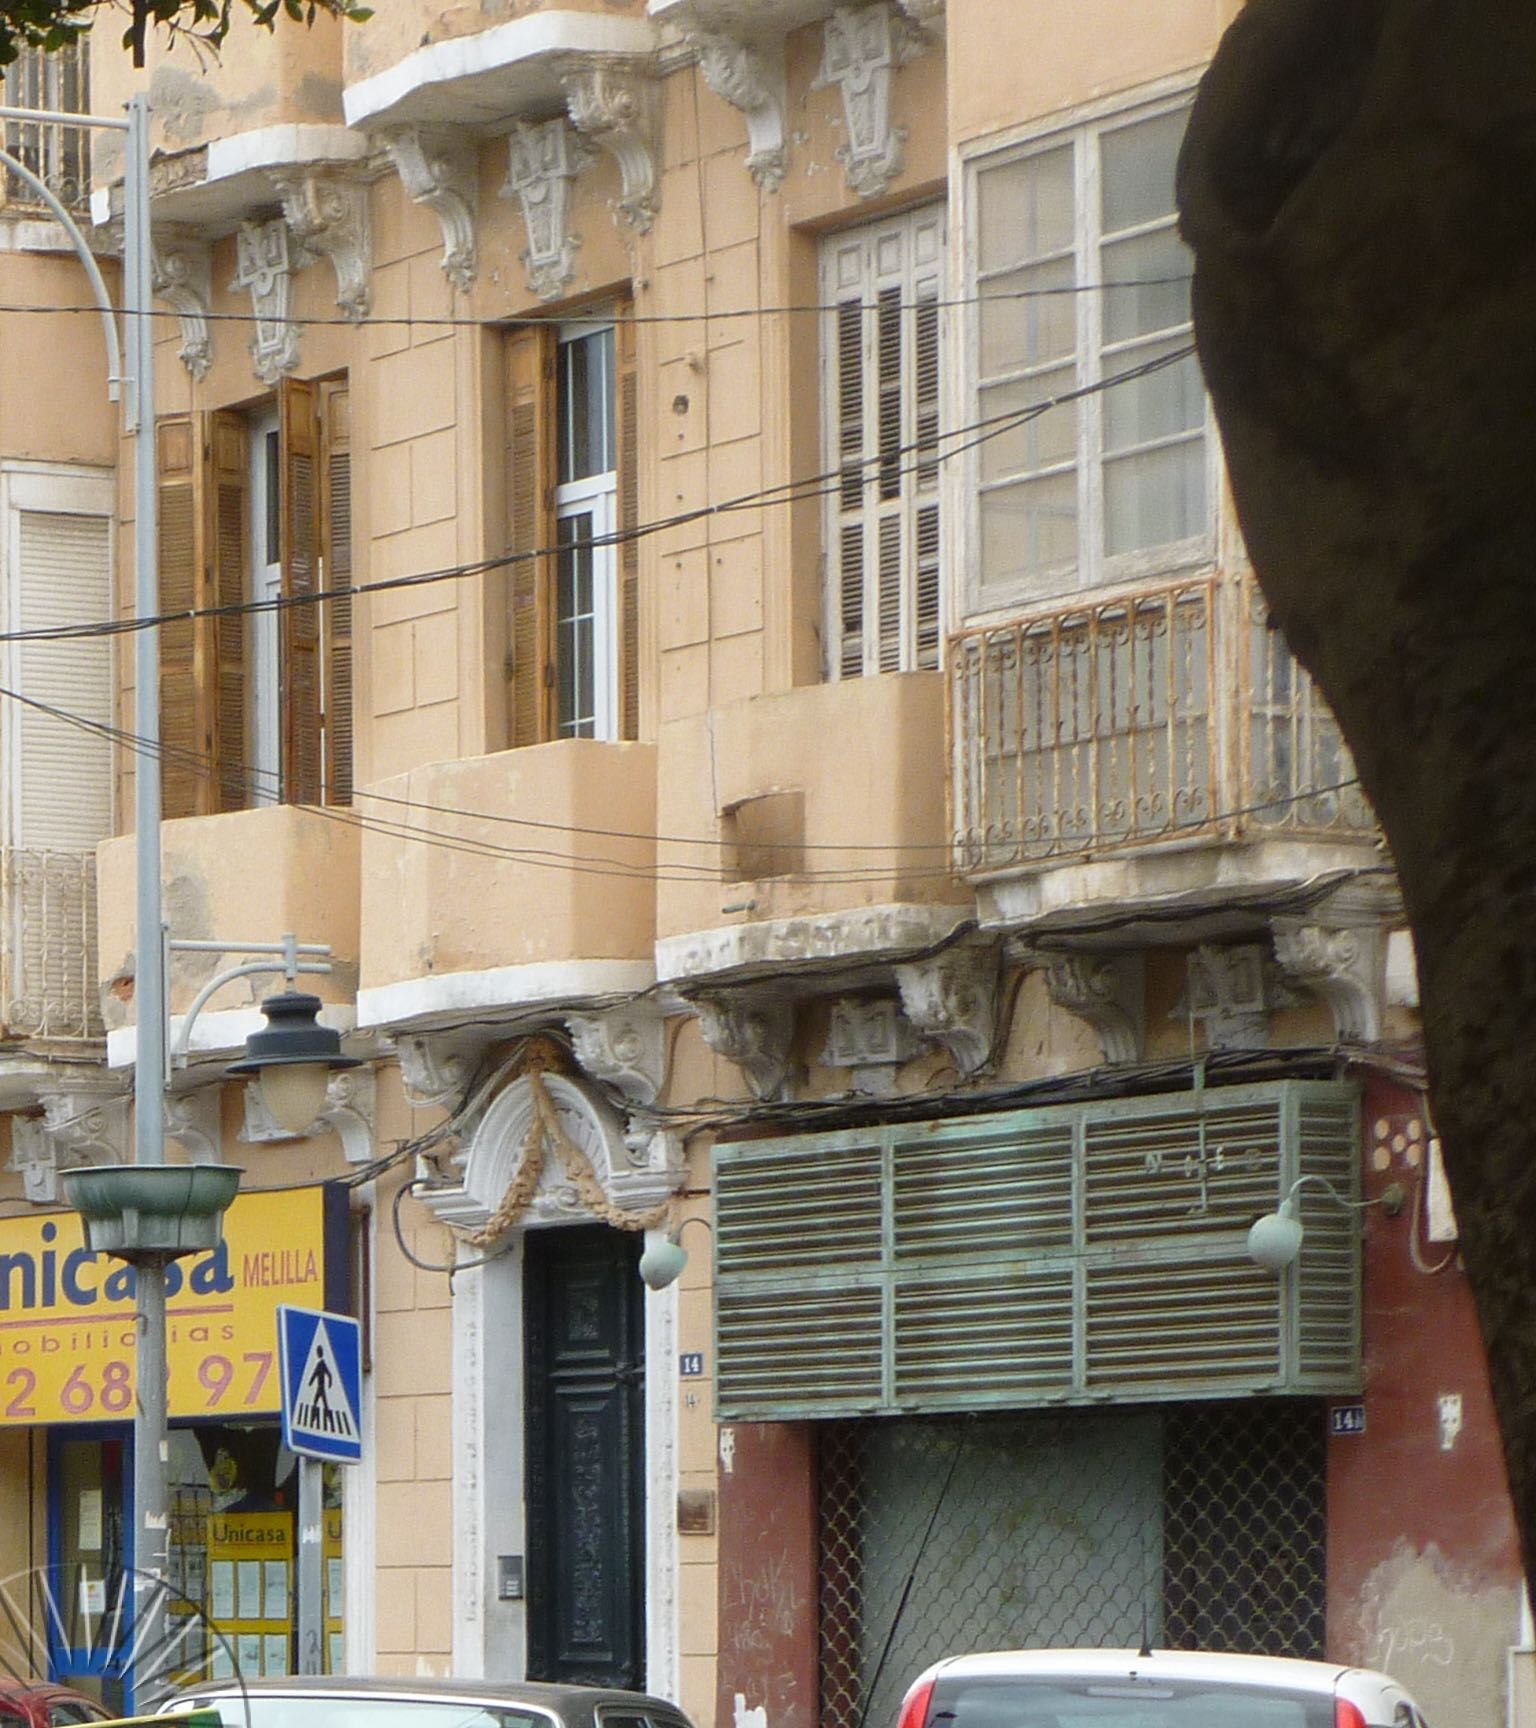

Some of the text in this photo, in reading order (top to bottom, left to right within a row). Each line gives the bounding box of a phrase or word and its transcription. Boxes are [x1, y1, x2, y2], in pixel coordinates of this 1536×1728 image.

[242, 1247, 319, 1288] MELILLA
[683, 1355, 700, 1374] 14
[61, 1360, 171, 1415] 68
[213, 1523, 286, 1543] Unicasa
